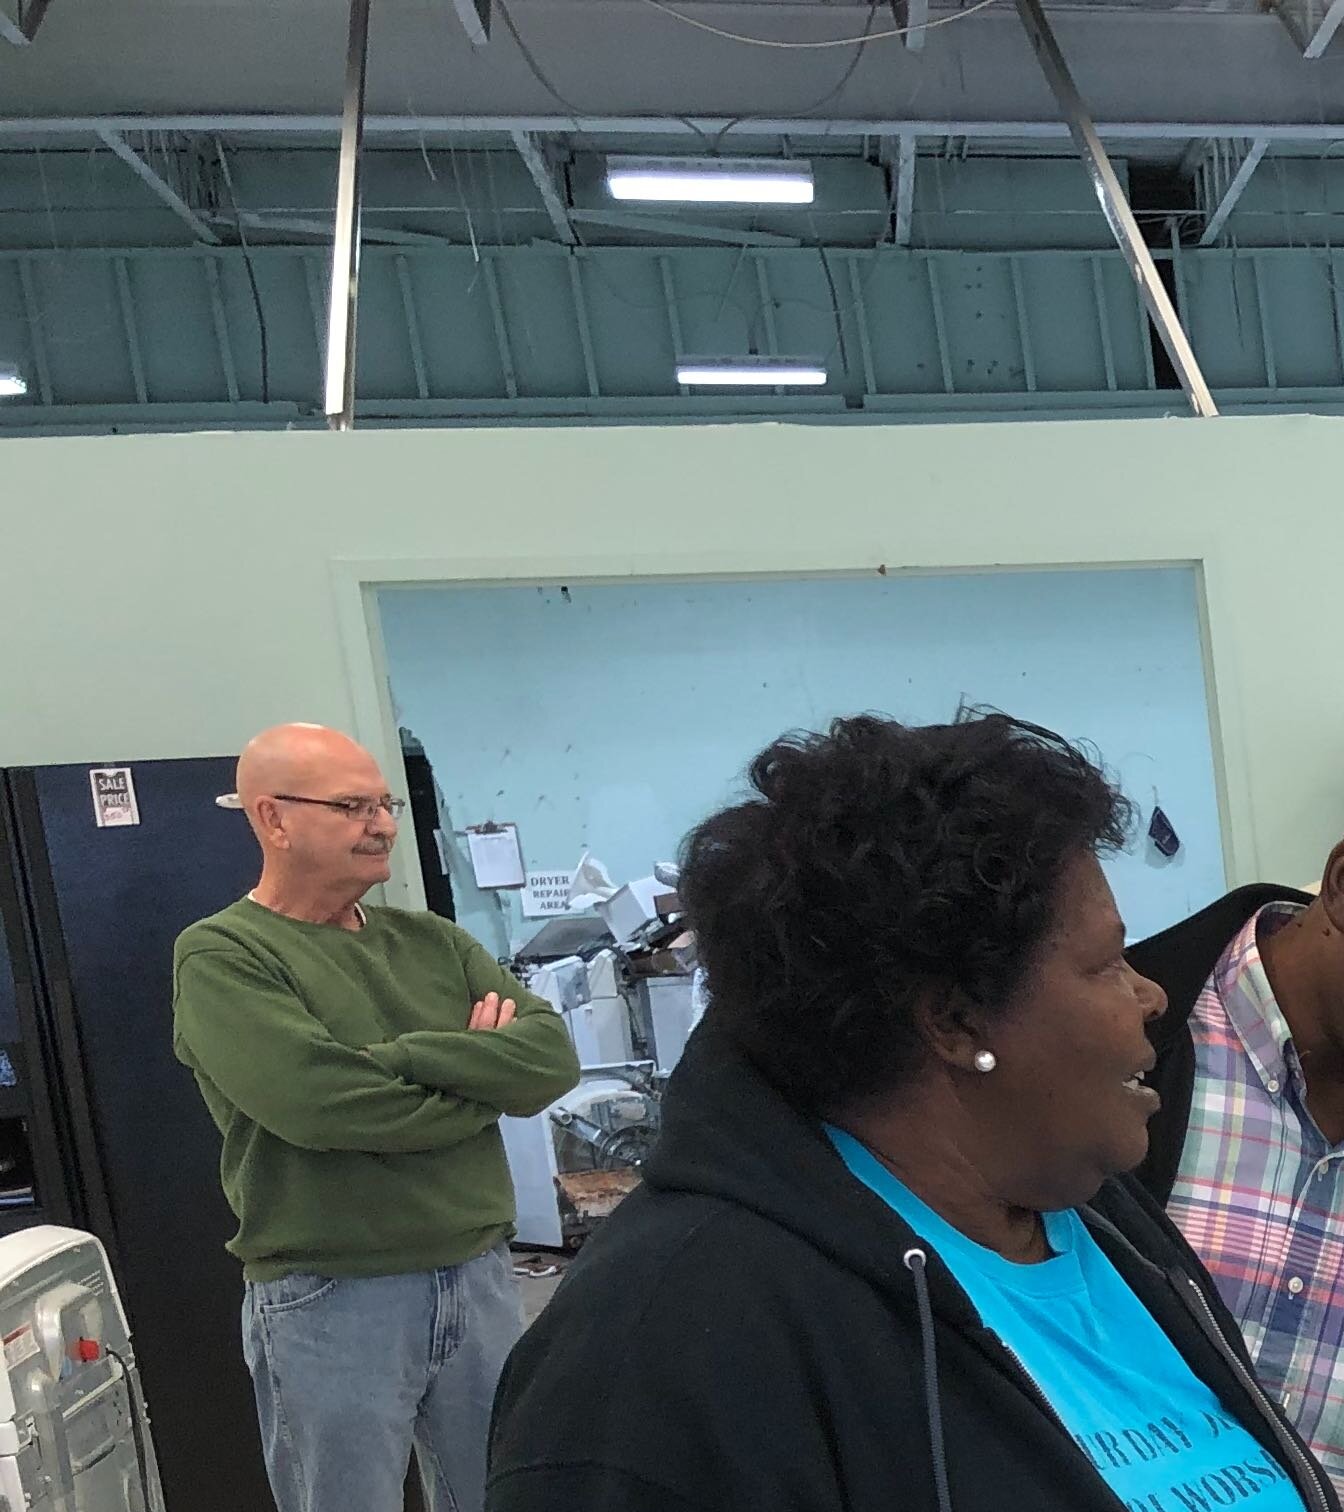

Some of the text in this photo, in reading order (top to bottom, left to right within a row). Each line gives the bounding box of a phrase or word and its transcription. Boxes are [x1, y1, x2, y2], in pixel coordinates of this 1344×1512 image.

[99, 777, 125, 790] SALE
[100, 793, 129, 806] PRICE
[530, 875, 570, 886] DRYER
